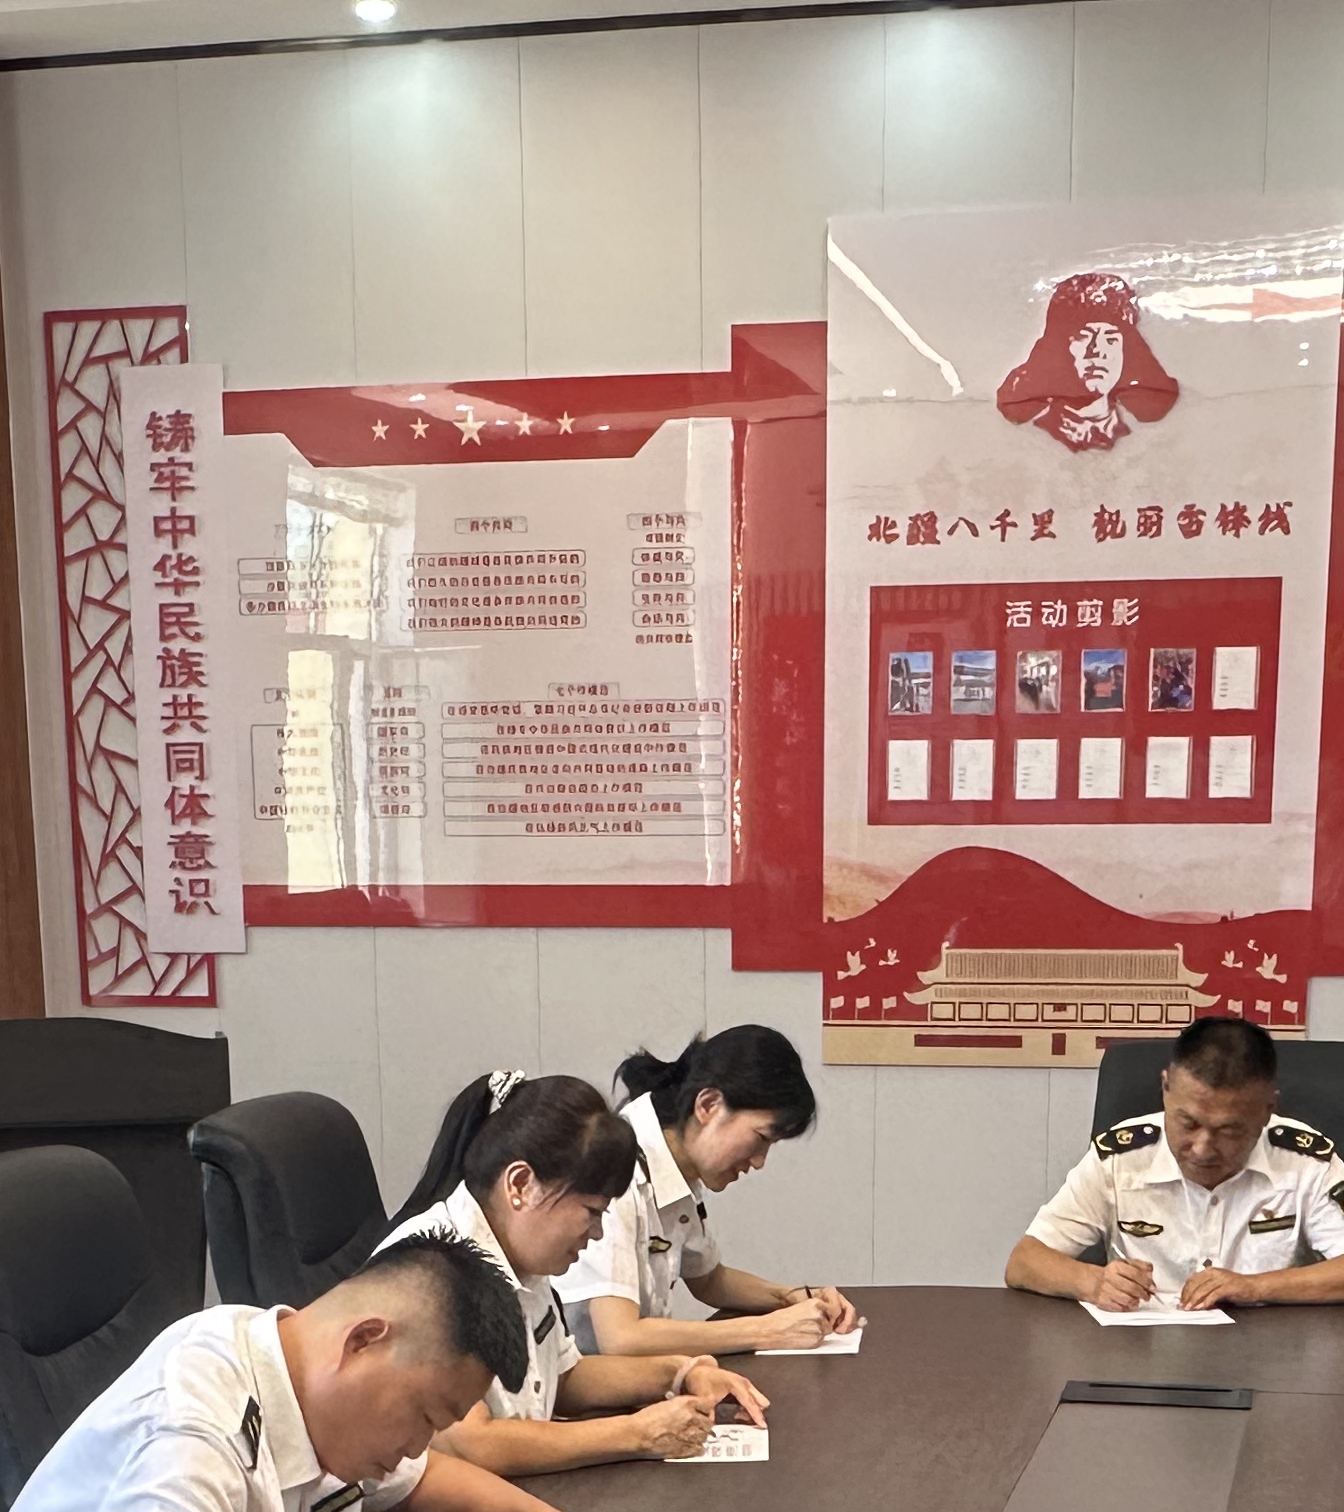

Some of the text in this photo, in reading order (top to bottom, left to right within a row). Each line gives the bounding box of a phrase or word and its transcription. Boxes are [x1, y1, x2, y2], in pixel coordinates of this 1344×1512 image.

[867, 509, 1057, 546] 北疆八千里
[1005, 598, 1140, 629] 活动剪影
[144, 408, 220, 917] 铸牢中华民族共同体意识
